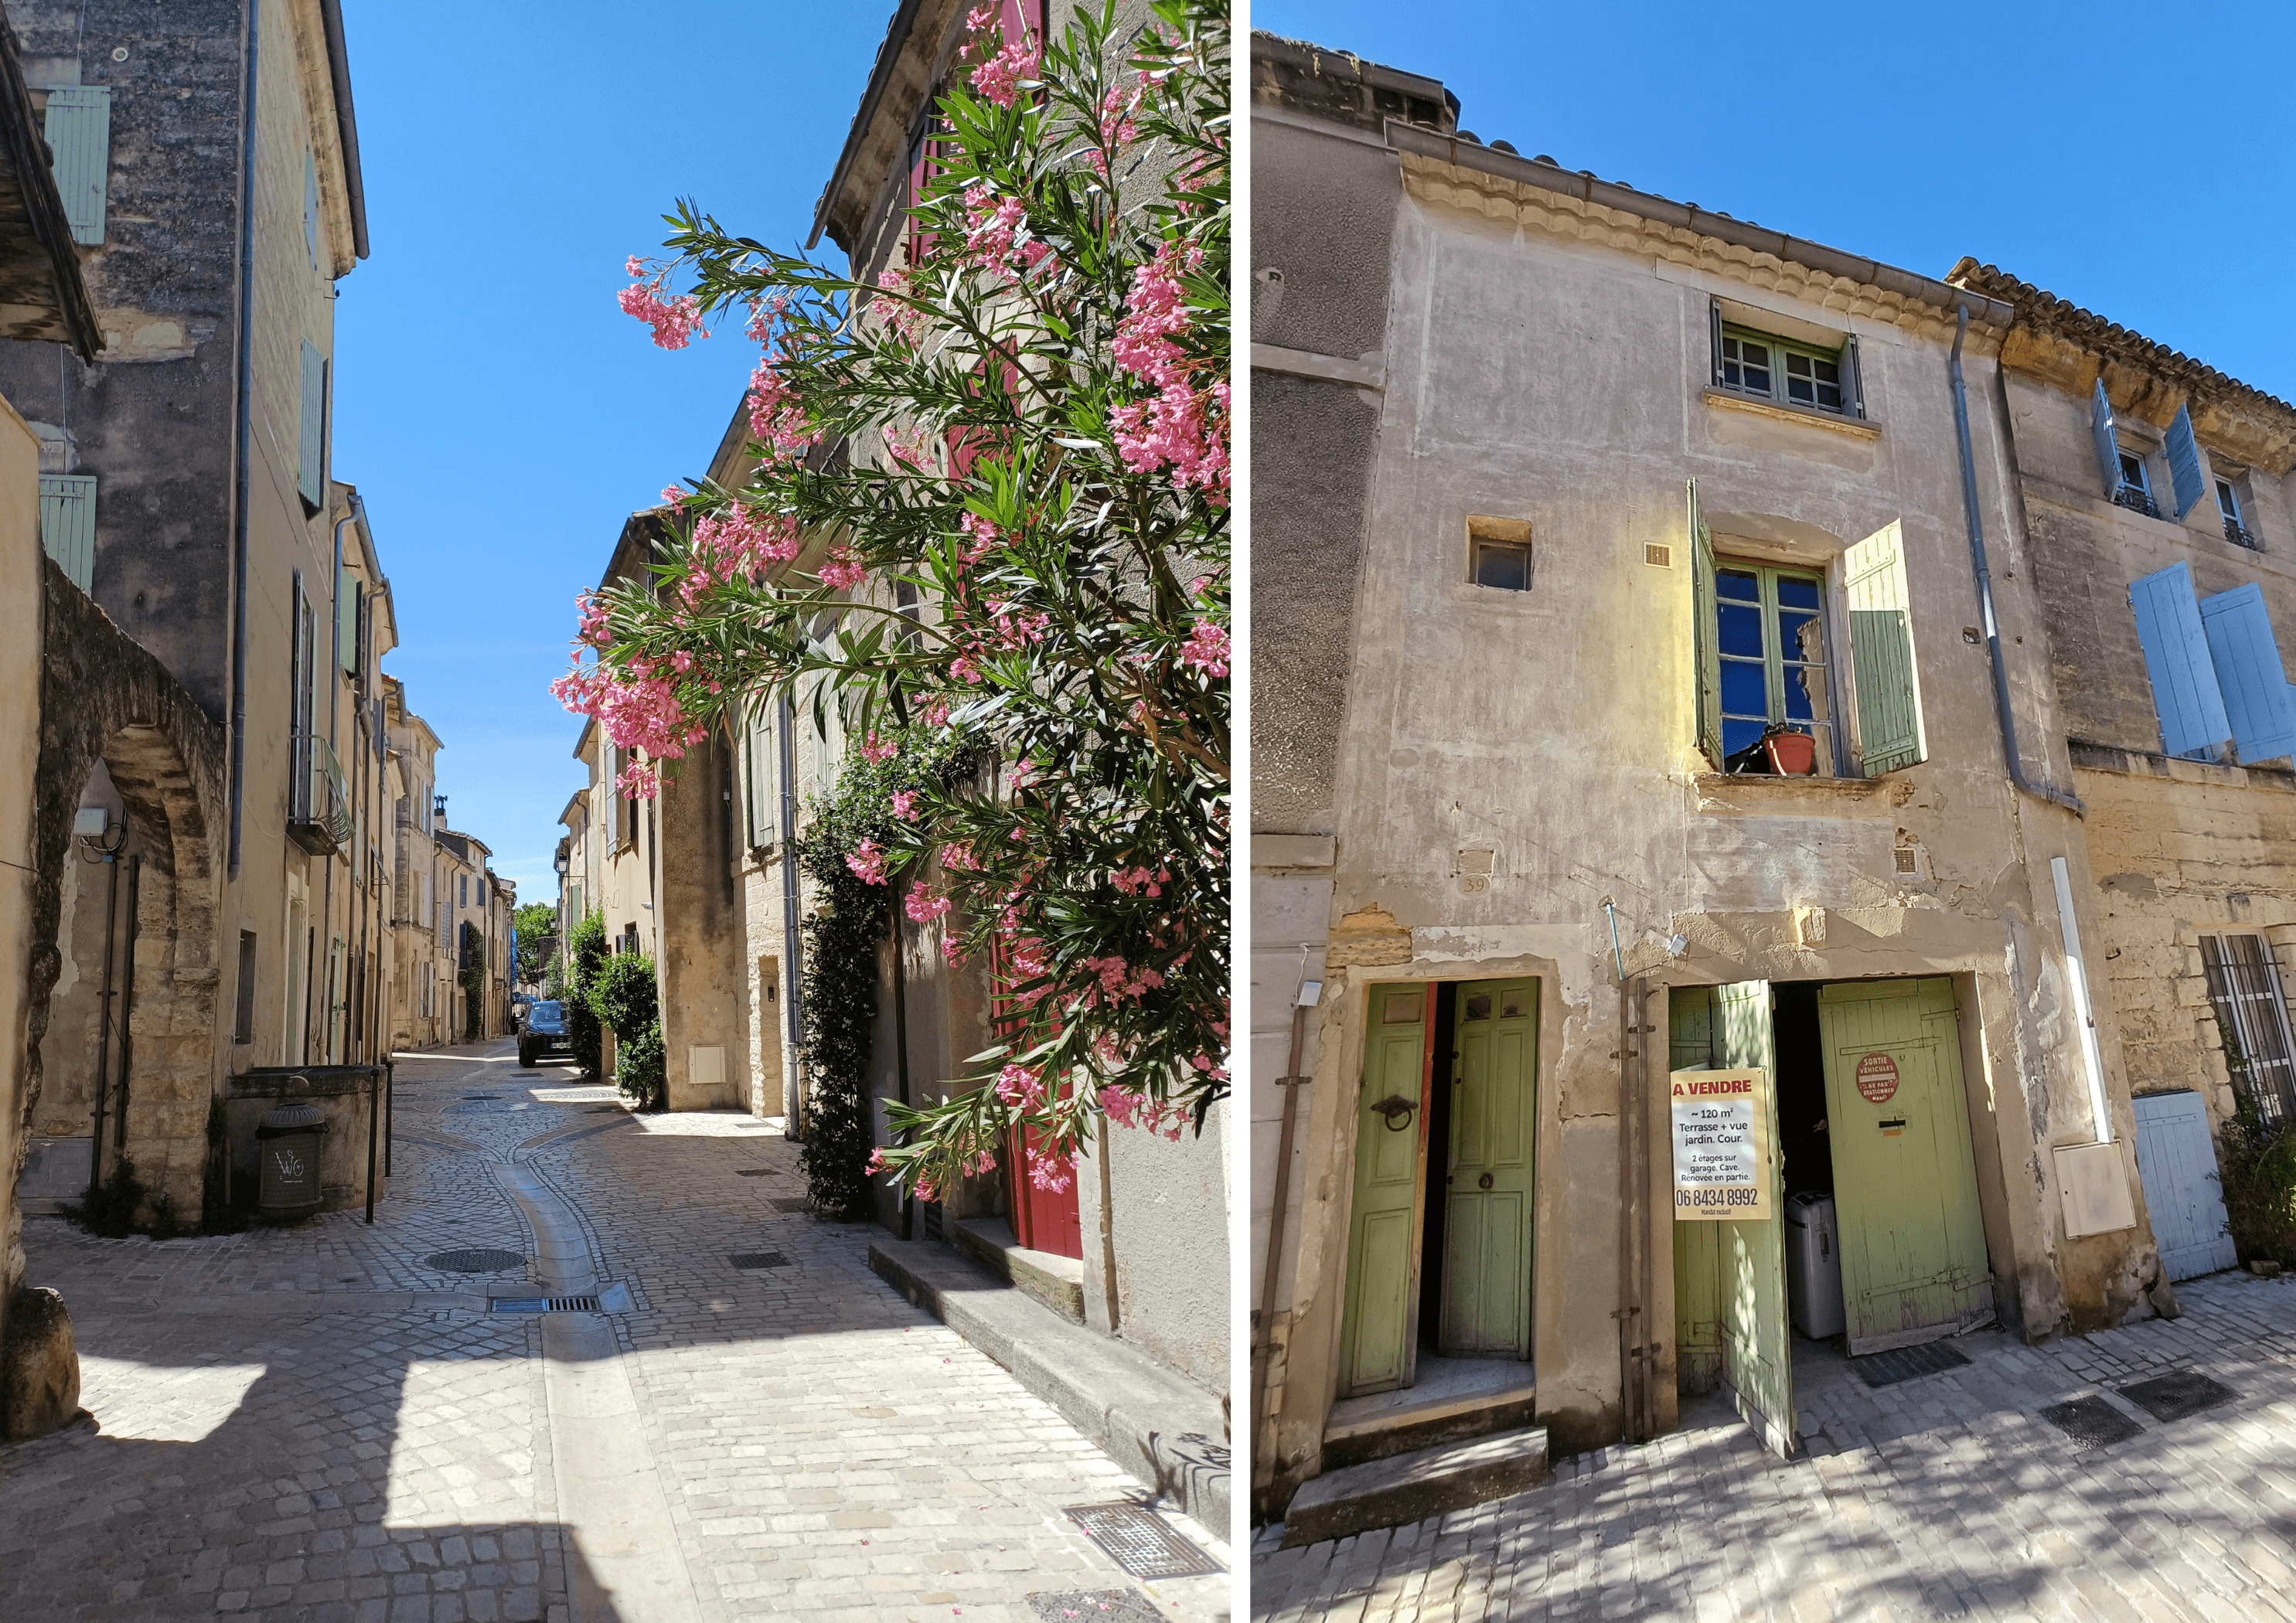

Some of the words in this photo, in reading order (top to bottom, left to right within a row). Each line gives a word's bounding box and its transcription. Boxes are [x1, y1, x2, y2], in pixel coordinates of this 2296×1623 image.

[1463, 878, 1484, 893] 39
[1864, 1056, 1887, 1065] SORTIE
[1673, 1084, 1685, 1096] A
[1688, 1080, 1752, 1095] VENDRE
[1863, 1087, 1894, 1096] STATIONNER
[1701, 1109, 1718, 1118] 120
[1679, 1123, 1719, 1132] Terrasse
[1685, 1134, 1715, 1147] jardin.
[1717, 1134, 1742, 1143] Cour.
[1698, 1155, 1723, 1163] étages
[1690, 1165, 1718, 1174] garage.
[1725, 1172, 1751, 1182] partie.
[1676, 1189, 1691, 1206] 06
[1693, 1189, 1725, 1206] 8434
[1726, 1188, 1758, 1206] 8992
